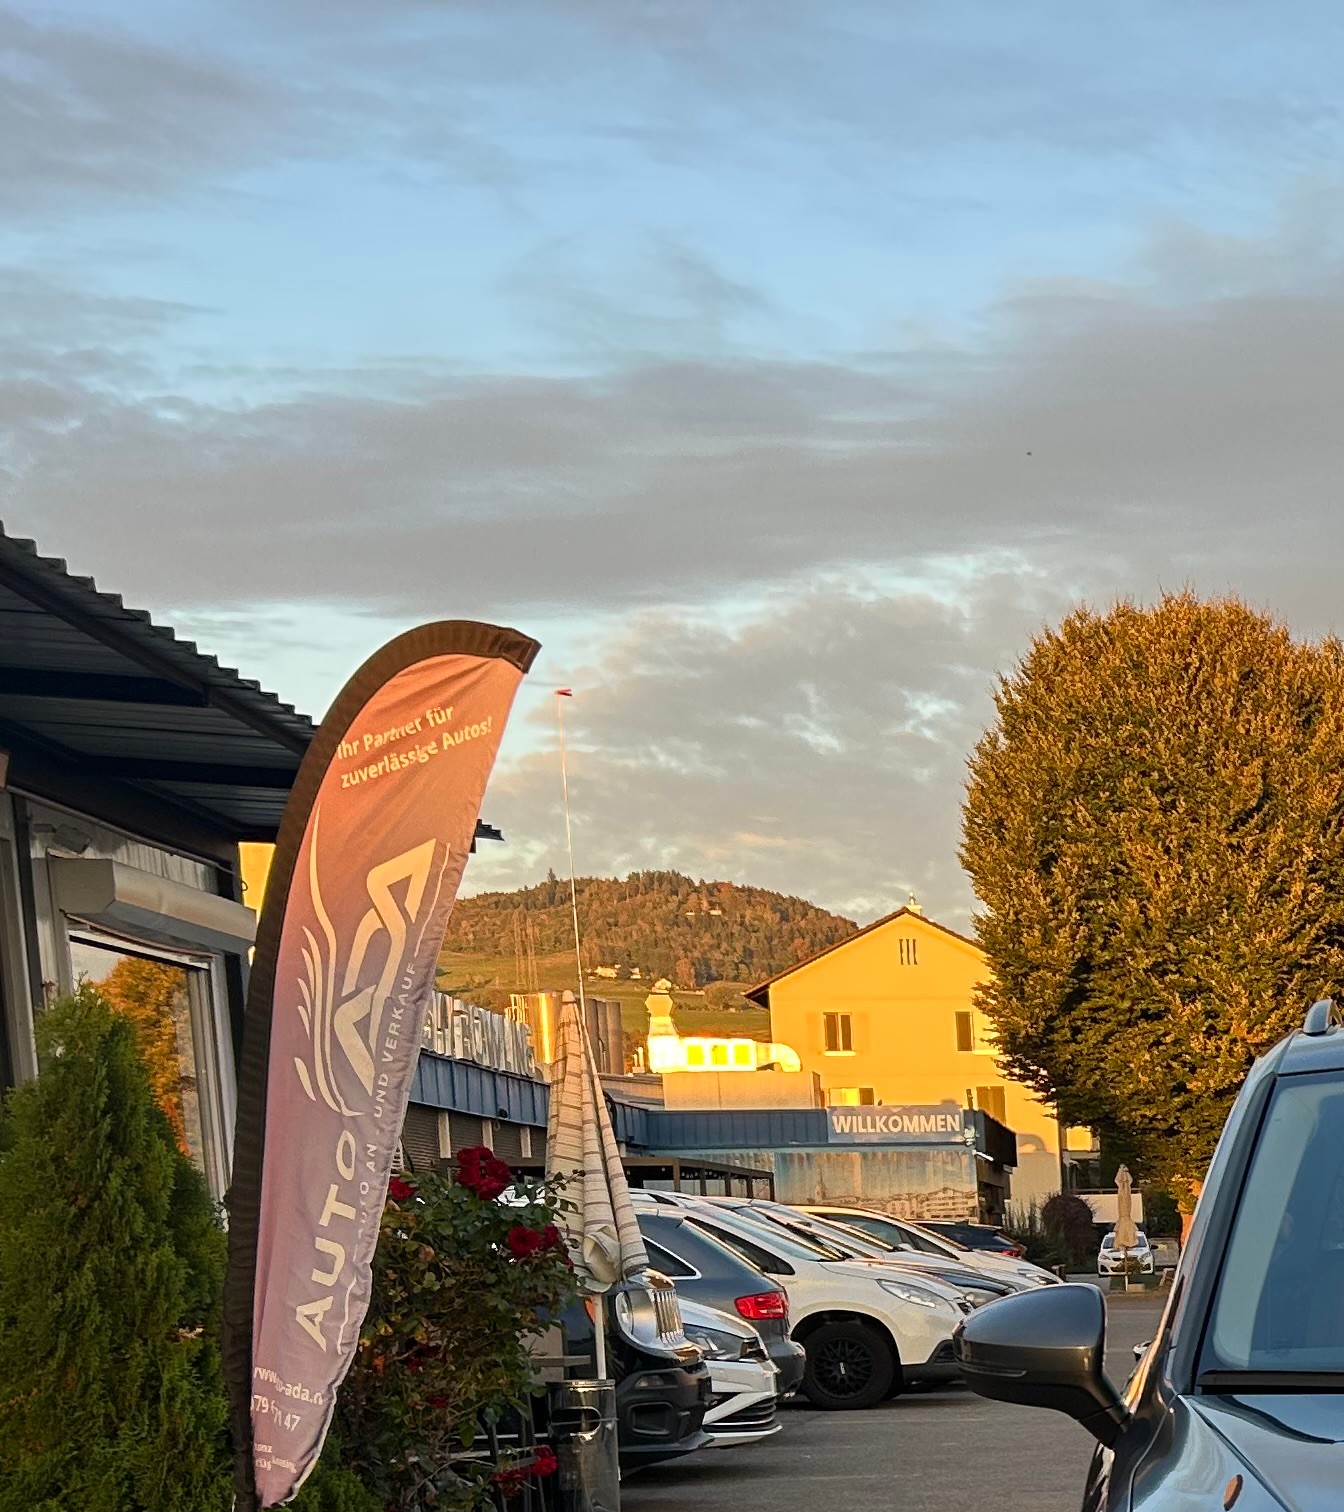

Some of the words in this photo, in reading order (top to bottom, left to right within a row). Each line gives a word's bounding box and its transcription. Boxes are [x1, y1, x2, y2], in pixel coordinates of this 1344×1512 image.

[337, 740, 359, 760] Ihr
[363, 717, 422, 751] Partner
[425, 706, 454, 727] für
[341, 740, 438, 789] zuverlässige
[442, 715, 493, 750] Autos!
[381, 962, 416, 1062] VERKAUF
[374, 1074, 389, 1118] UND
[832, 1114, 960, 1133] WILLKOMMEN
[365, 1143, 378, 1173] AN
[296, 1130, 356, 1353] AUTO
[251, 1394, 268, 1413] 79
